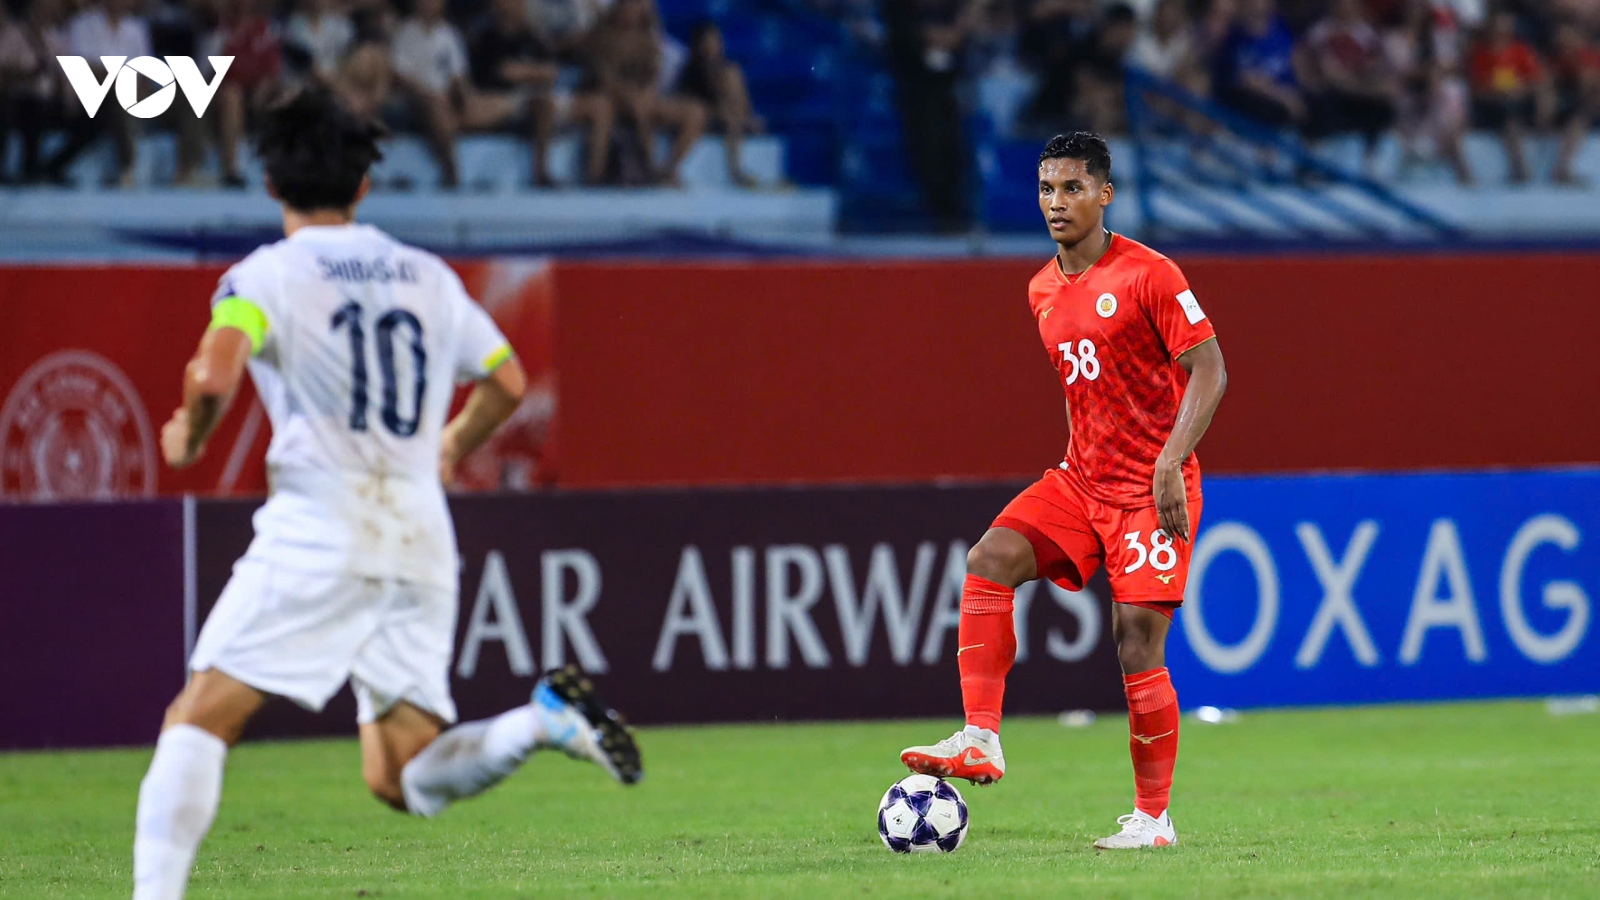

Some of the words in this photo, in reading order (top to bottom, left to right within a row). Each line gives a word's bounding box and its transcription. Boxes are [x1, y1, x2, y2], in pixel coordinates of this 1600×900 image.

[330, 298, 427, 437] 10
[1057, 338, 1101, 386] 38
[457, 549, 609, 679] AR
[1124, 528, 1177, 574] 38
[1181, 512, 1592, 673] OXAG
